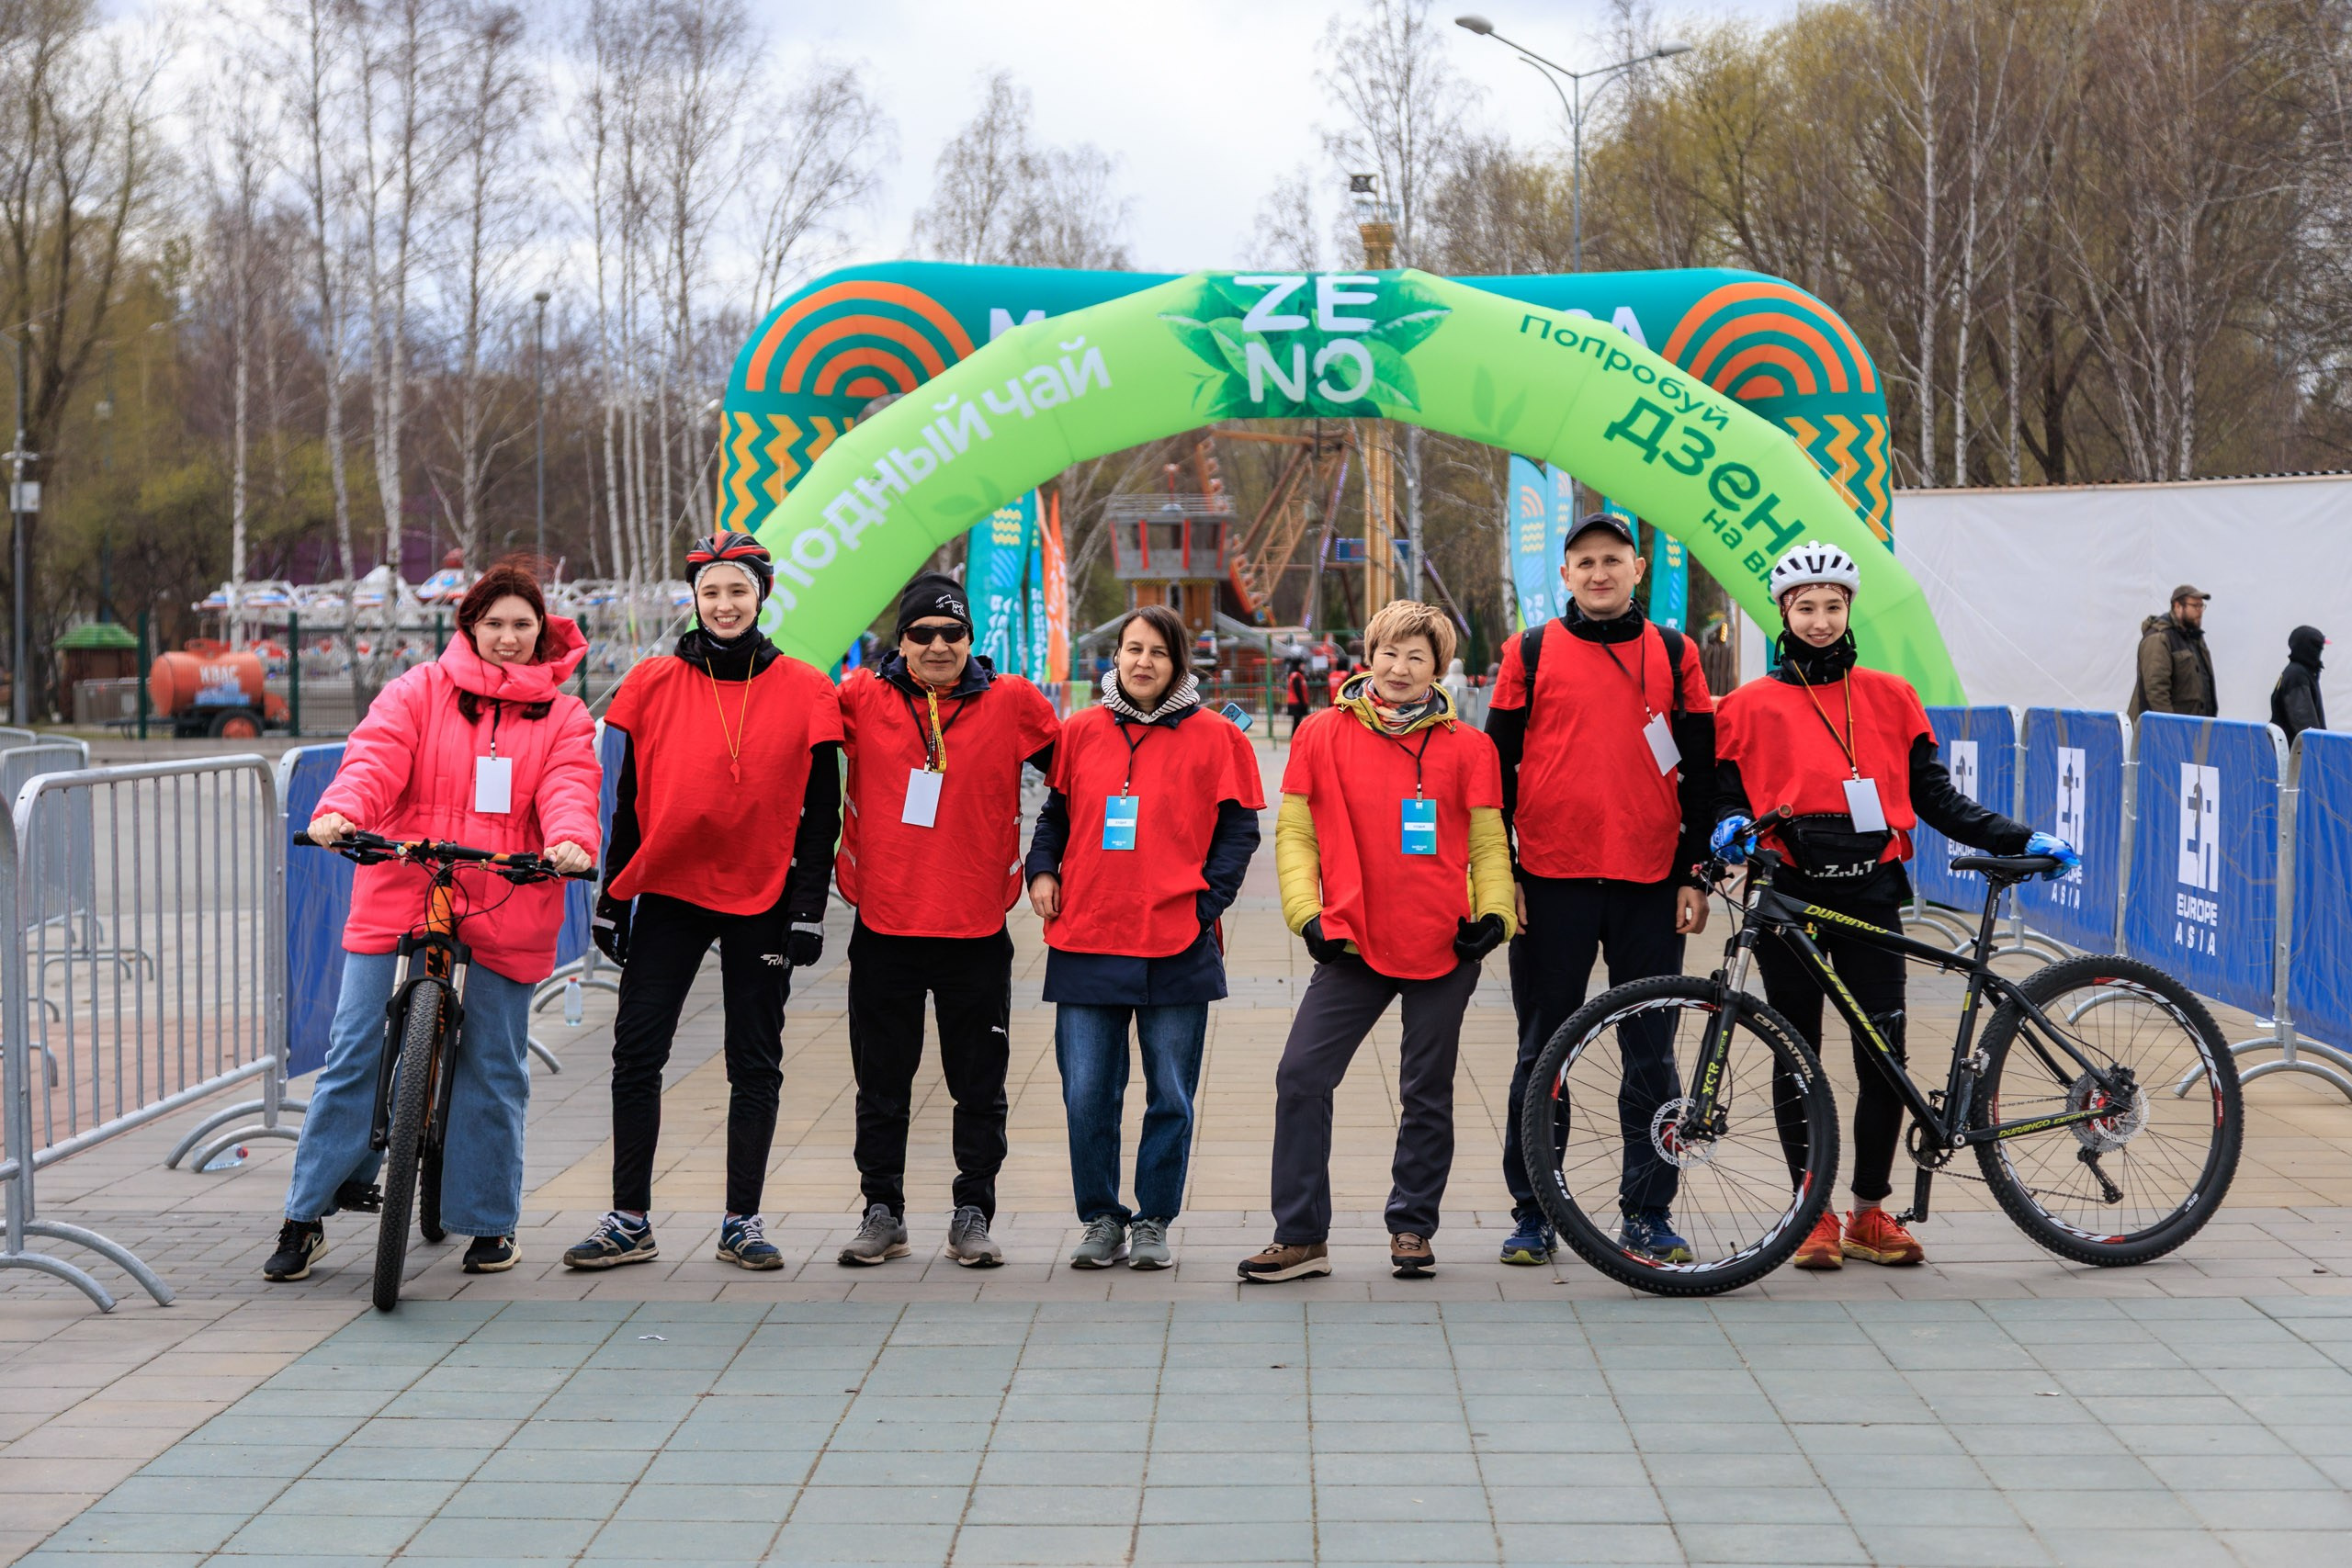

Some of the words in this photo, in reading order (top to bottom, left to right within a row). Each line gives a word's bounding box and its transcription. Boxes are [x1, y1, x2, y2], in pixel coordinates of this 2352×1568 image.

[1234, 276, 1379, 333] ZE
[1245, 338, 1374, 403] NO
[759, 392, 994, 637] олодный
[981, 336, 1113, 420] чай
[1702, 508, 1743, 550] на
[2051, 883, 2080, 909] ASIA
[2177, 893, 2218, 927] EUROPE
[2175, 921, 2215, 956] ASIA
[1753, 1012, 1781, 1032] CST
[1776, 1031, 1815, 1084] PATROL
[1702, 1061, 1720, 1096] XCR
[1998, 1119, 2051, 1139] DURANGO
